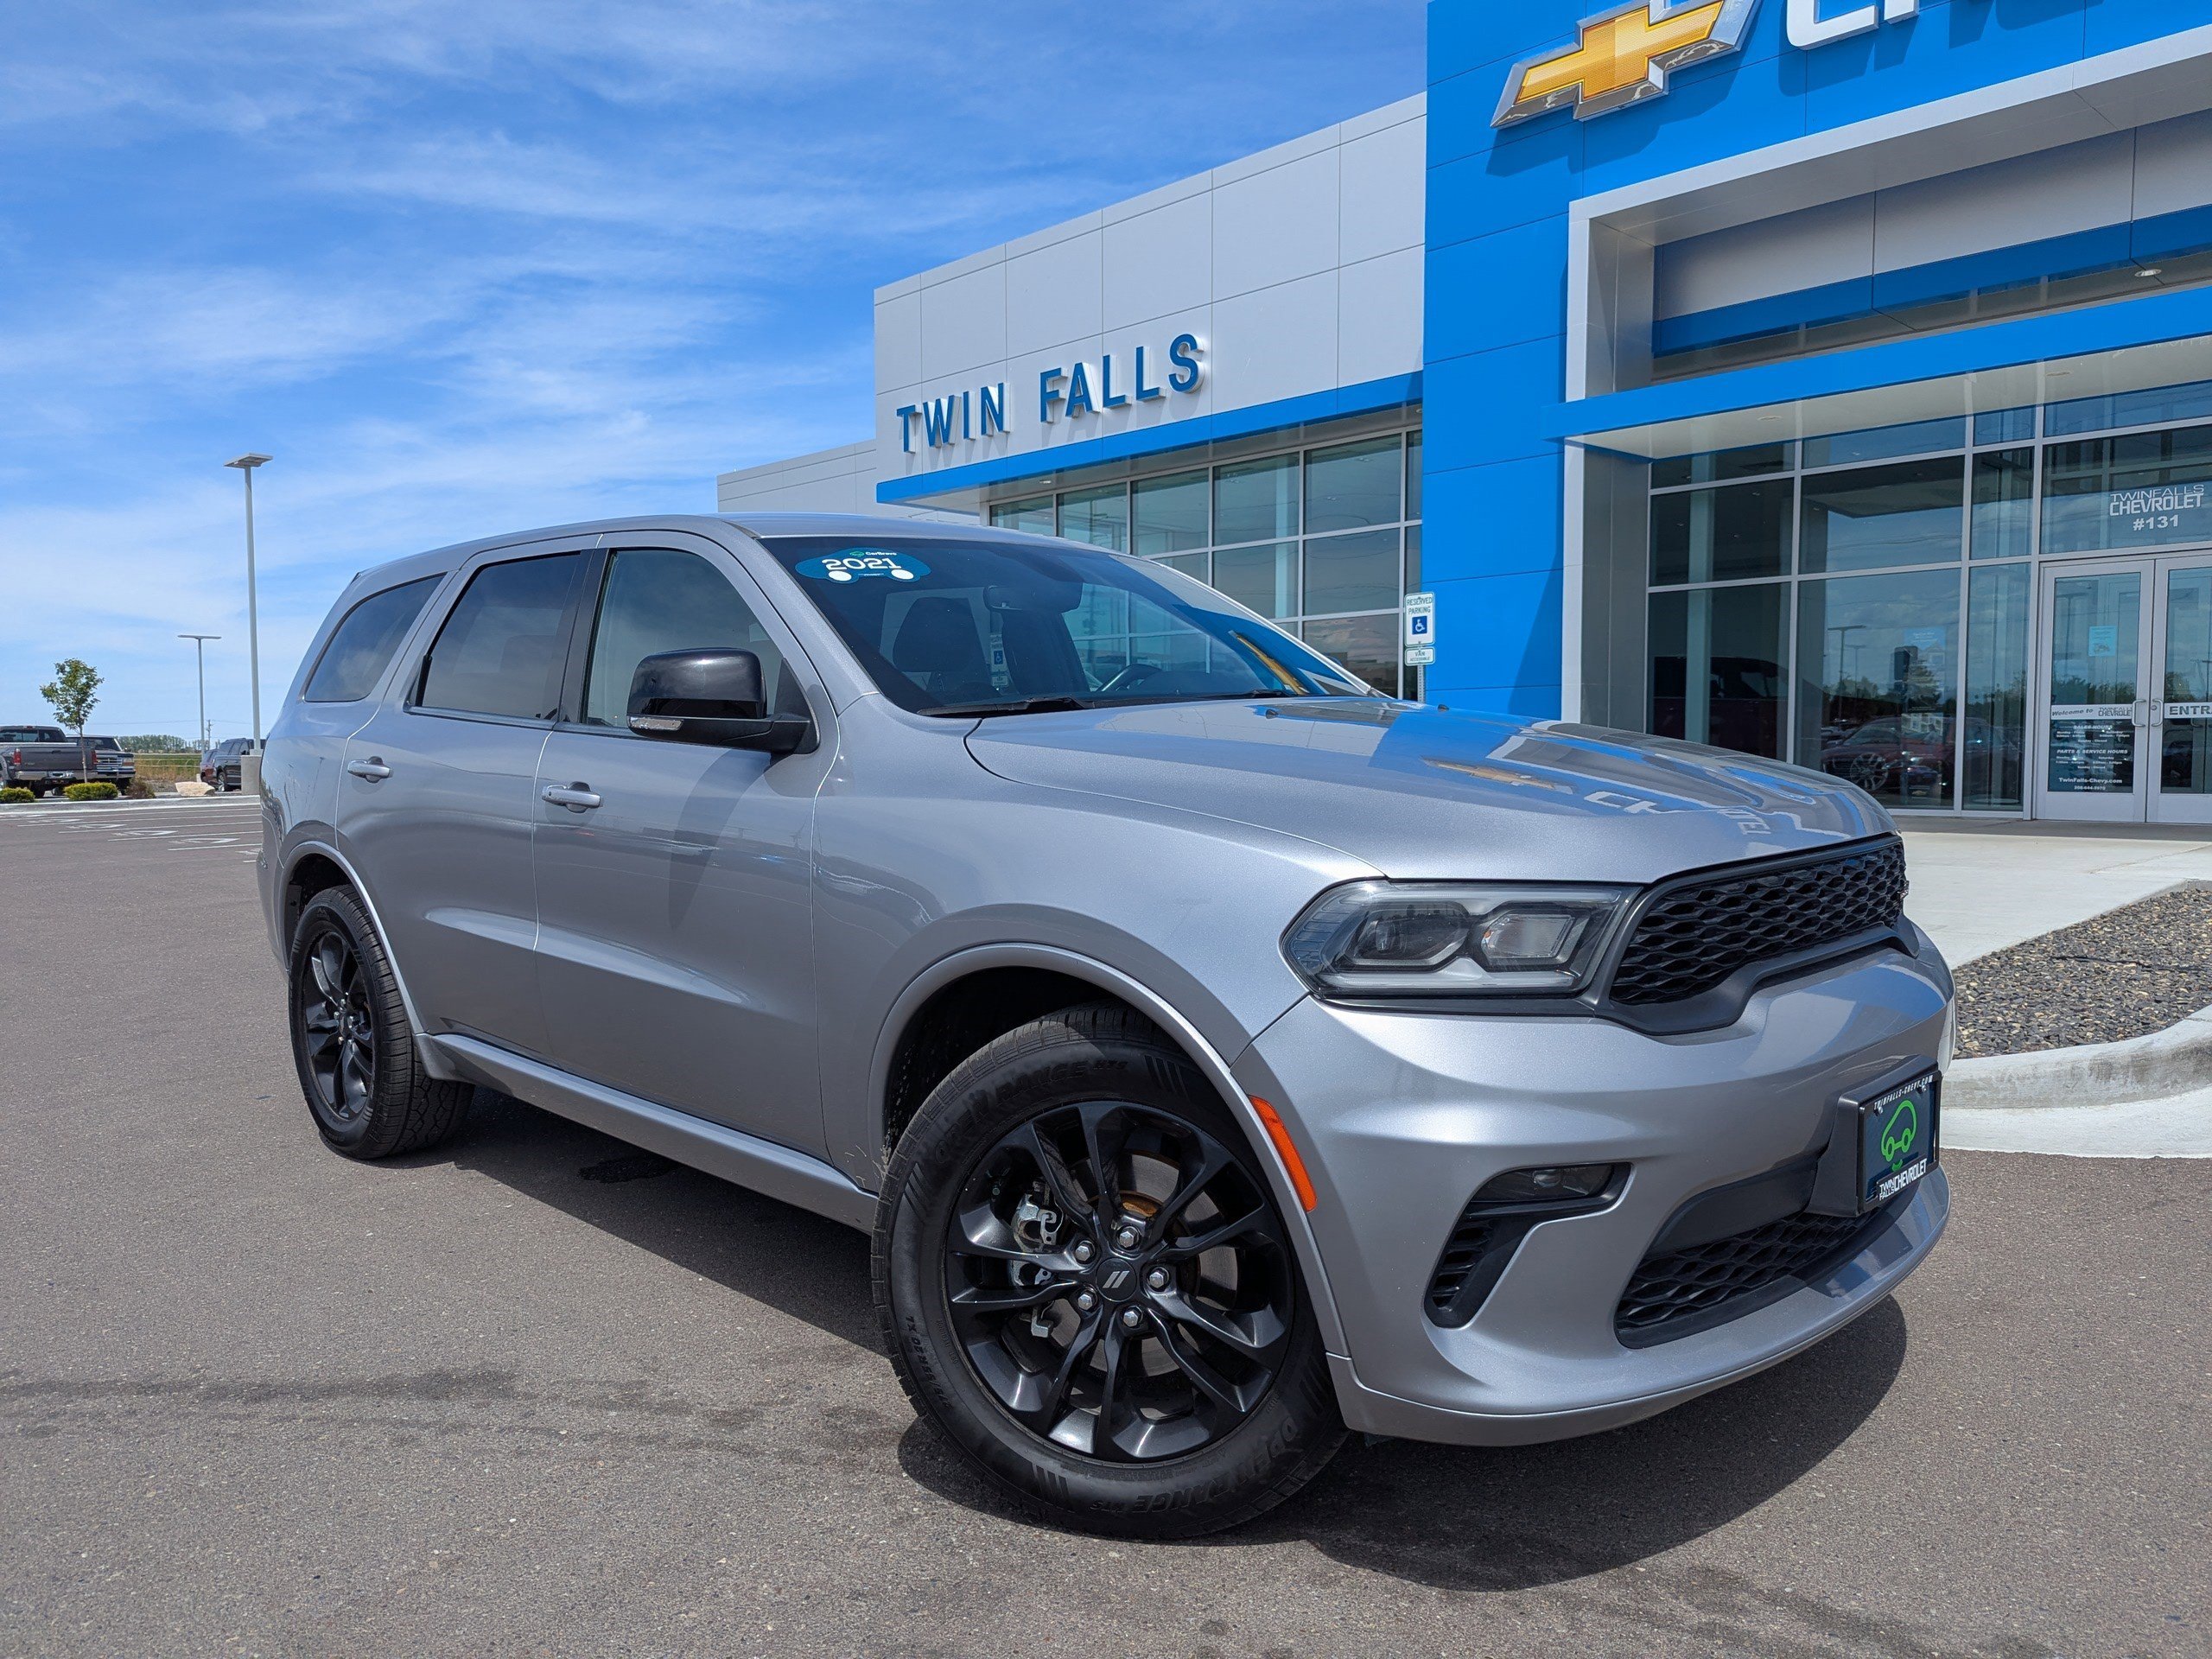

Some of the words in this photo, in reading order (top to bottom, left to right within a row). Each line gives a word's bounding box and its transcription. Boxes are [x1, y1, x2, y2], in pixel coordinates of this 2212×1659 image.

[896, 383, 1011, 454] TWIN
[1039, 334, 1205, 423] FALLS
[2110, 485, 2204, 502] TWINFALLS
[2110, 493, 2204, 516] CHEVROLET
[2133, 515, 2178, 531] #131
[822, 557, 901, 570] 2021
[1407, 596, 1433, 606] RESERVED
[1408, 607, 1431, 615] PARKING
[2169, 705, 2212, 715] ENTR
[1894, 1158, 1928, 1192] CHEVROLET
